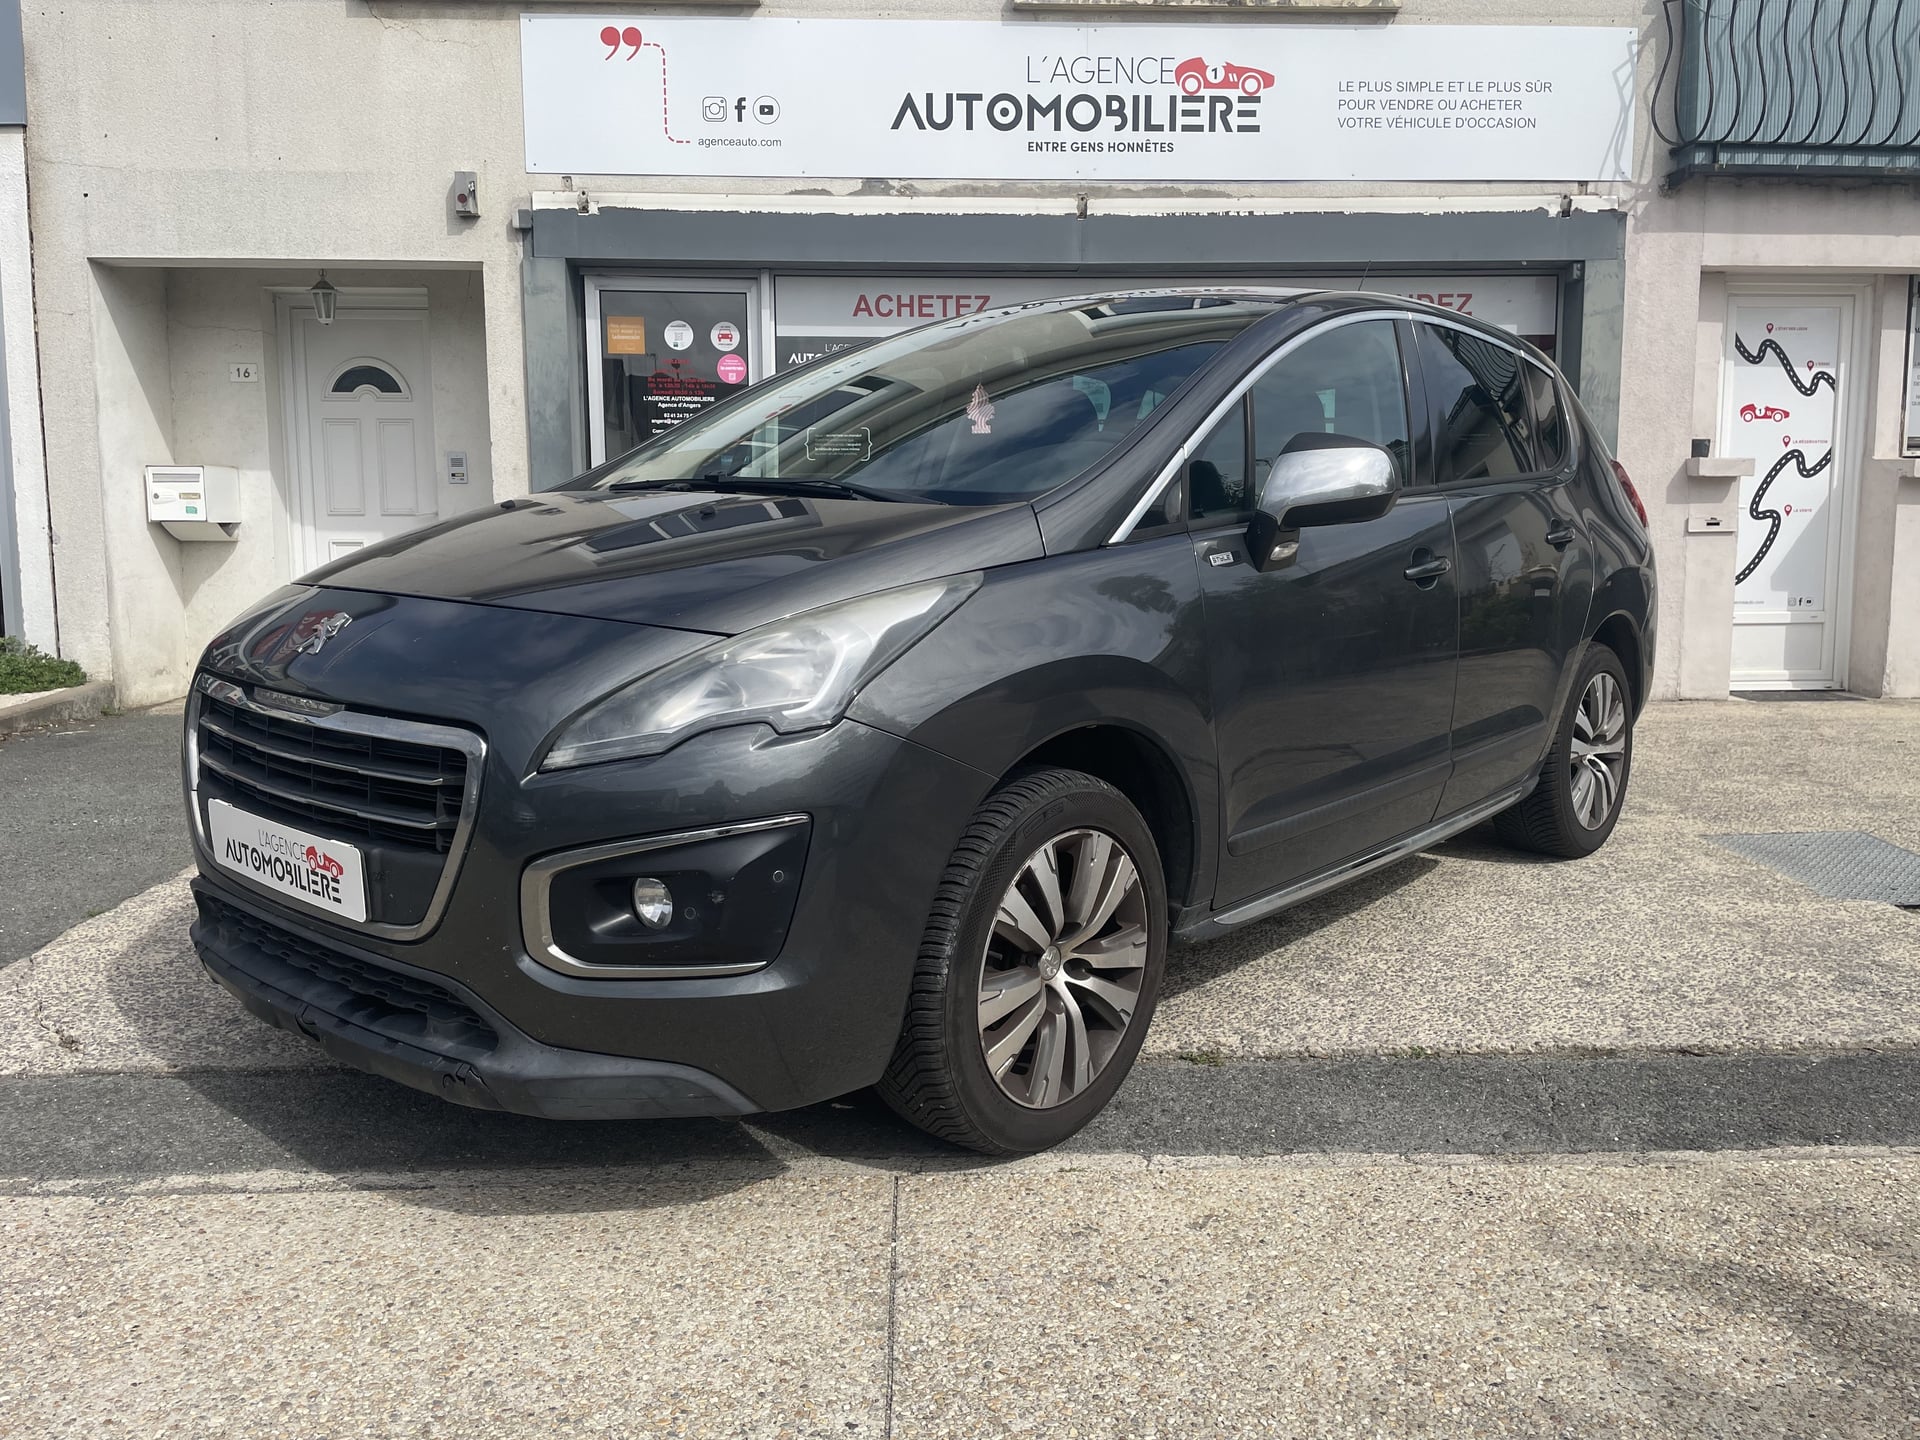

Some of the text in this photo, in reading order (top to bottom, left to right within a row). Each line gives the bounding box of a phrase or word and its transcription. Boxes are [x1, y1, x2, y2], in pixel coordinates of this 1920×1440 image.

[1027, 55, 1175, 85] L'AGENCE
[1211, 67, 1218, 80] 1
[1338, 79, 1553, 93] LE PLUS SIMPLE ET LE PLUS SÛR
[1338, 99, 1522, 111] POUR VENDRE OU ACHETER
[1337, 115, 1537, 129] VOTRE VÉHICULE D'OCCASION
[698, 137, 782, 148] agenceauto.com
[1027, 138, 1175, 153] ENTRE GENS HONNÊTES
[236, 367, 251, 378] 16
[258, 829, 307, 863] L'AGENCE
